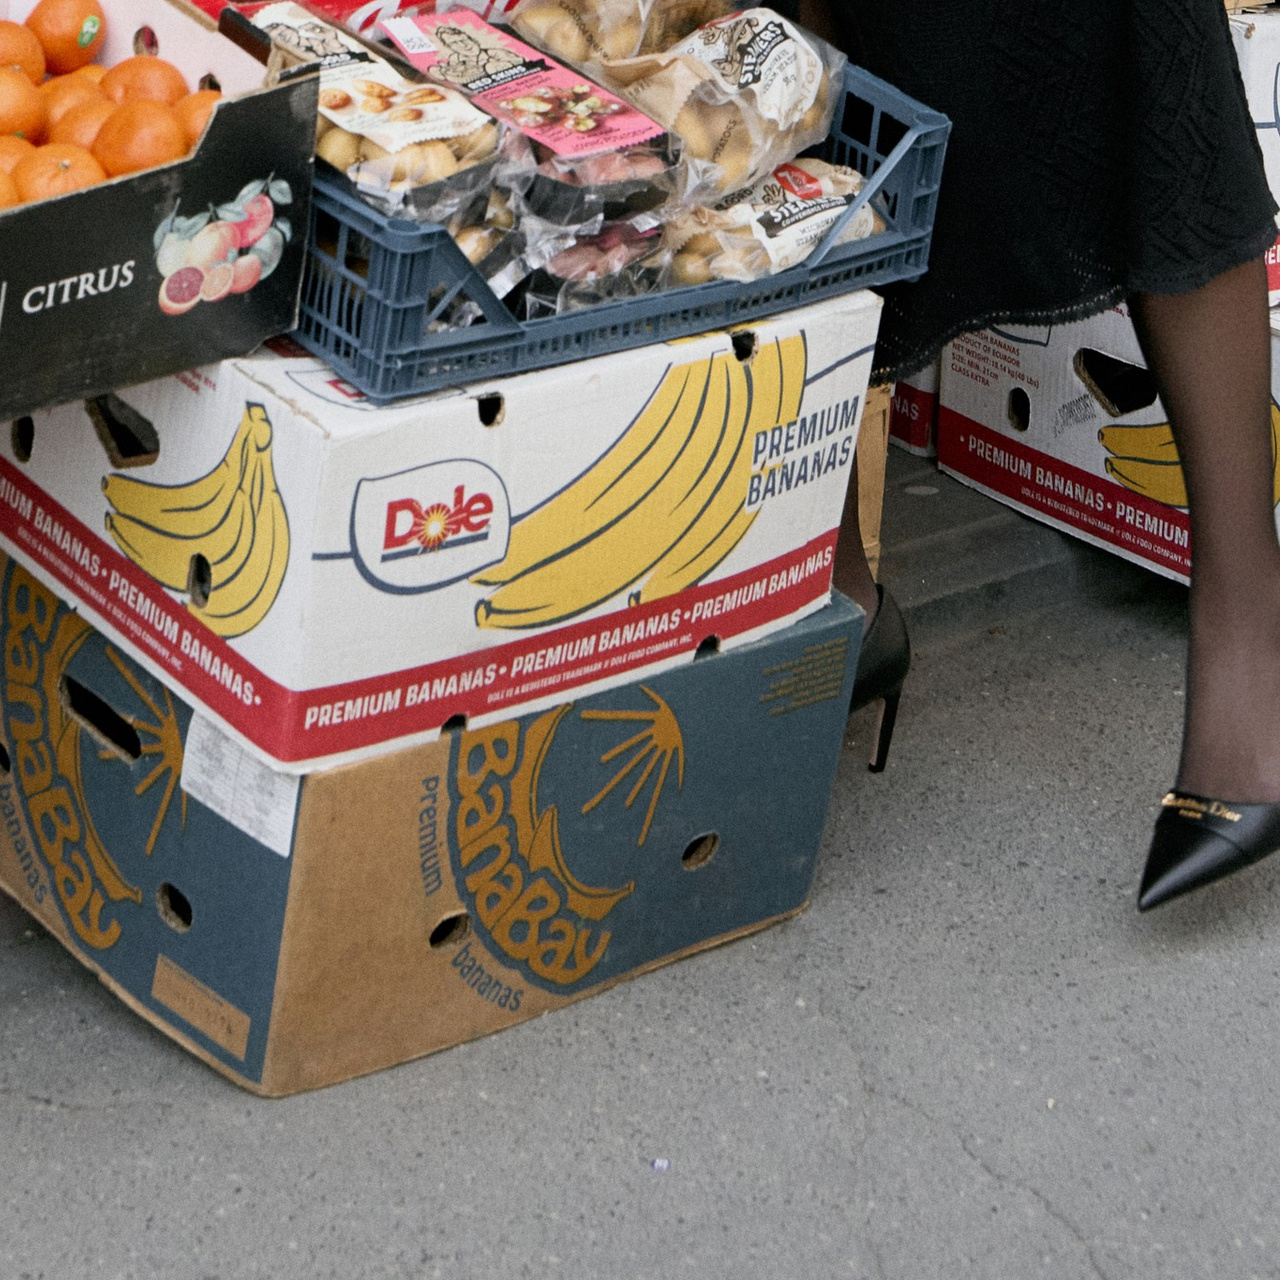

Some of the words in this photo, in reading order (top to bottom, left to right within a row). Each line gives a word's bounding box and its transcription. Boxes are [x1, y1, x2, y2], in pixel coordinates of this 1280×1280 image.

[23, 260, 137, 314] CITRUS
[951, 362, 970, 377] CLASS
[970, 370, 990, 387] EXTRA
[952, 341, 965, 353] NET
[983, 344, 991, 354] OF
[991, 347, 1021, 368] ECUADOR
[990, 336, 1020, 356] BANANAS
[753, 395, 859, 465] PREMIUM
[747, 435, 853, 507] BANANAS
[969, 434, 1032, 481] PREMIUM
[1035, 466, 1105, 511] BANANAS
[1116, 502, 1189, 549] PREMIUM
[382, 484, 494, 551] Dole
[34, 506, 102, 577] BANANAS
[109, 568, 180, 645] PREMIUM
[180, 629, 255, 707] BANANAS
[304, 686, 401, 730] PREMIUM
[406, 662, 497, 707] BANANAS
[511, 633, 598, 678] PREMIUM
[600, 608, 681, 652] BANANAS
[691, 581, 767, 624] PREMIUM
[768, 545, 832, 597] BANANAS
[451, 940, 524, 1012] bananas
